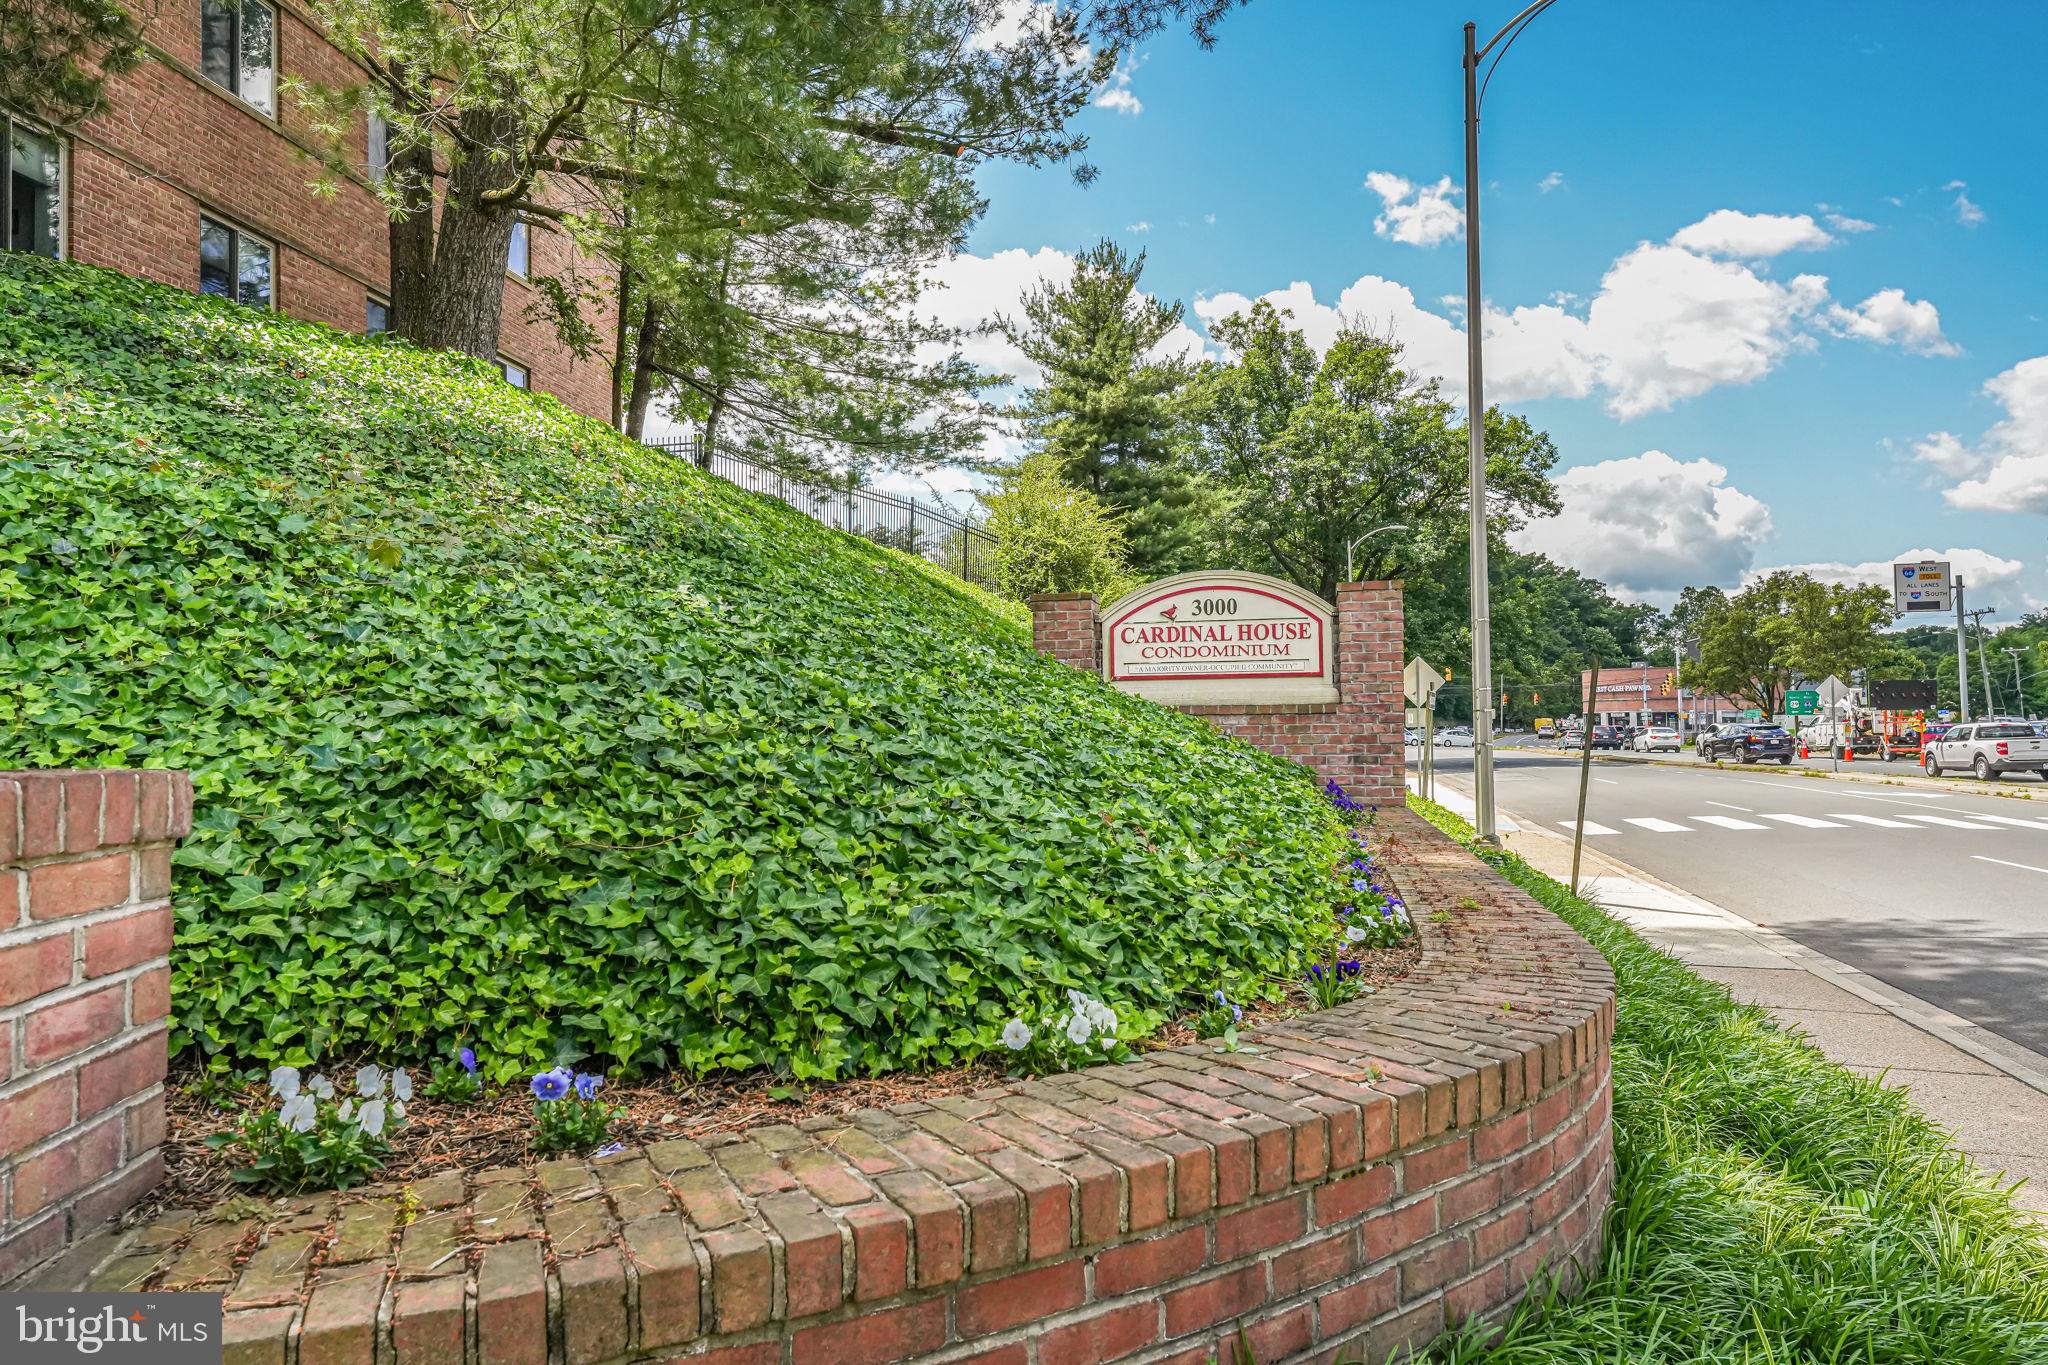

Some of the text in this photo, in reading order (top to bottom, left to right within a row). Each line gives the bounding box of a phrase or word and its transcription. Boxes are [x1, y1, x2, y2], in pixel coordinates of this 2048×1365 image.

[1191, 598, 1238, 616] 3000
[1121, 622, 1312, 644] CARDINAL HOUSE
[1141, 643, 1290, 659] CONDOMINIUM
[1143, 665, 1181, 673] MAJORITY
[1181, 663, 1246, 672] OWNER-OCCUPIED
